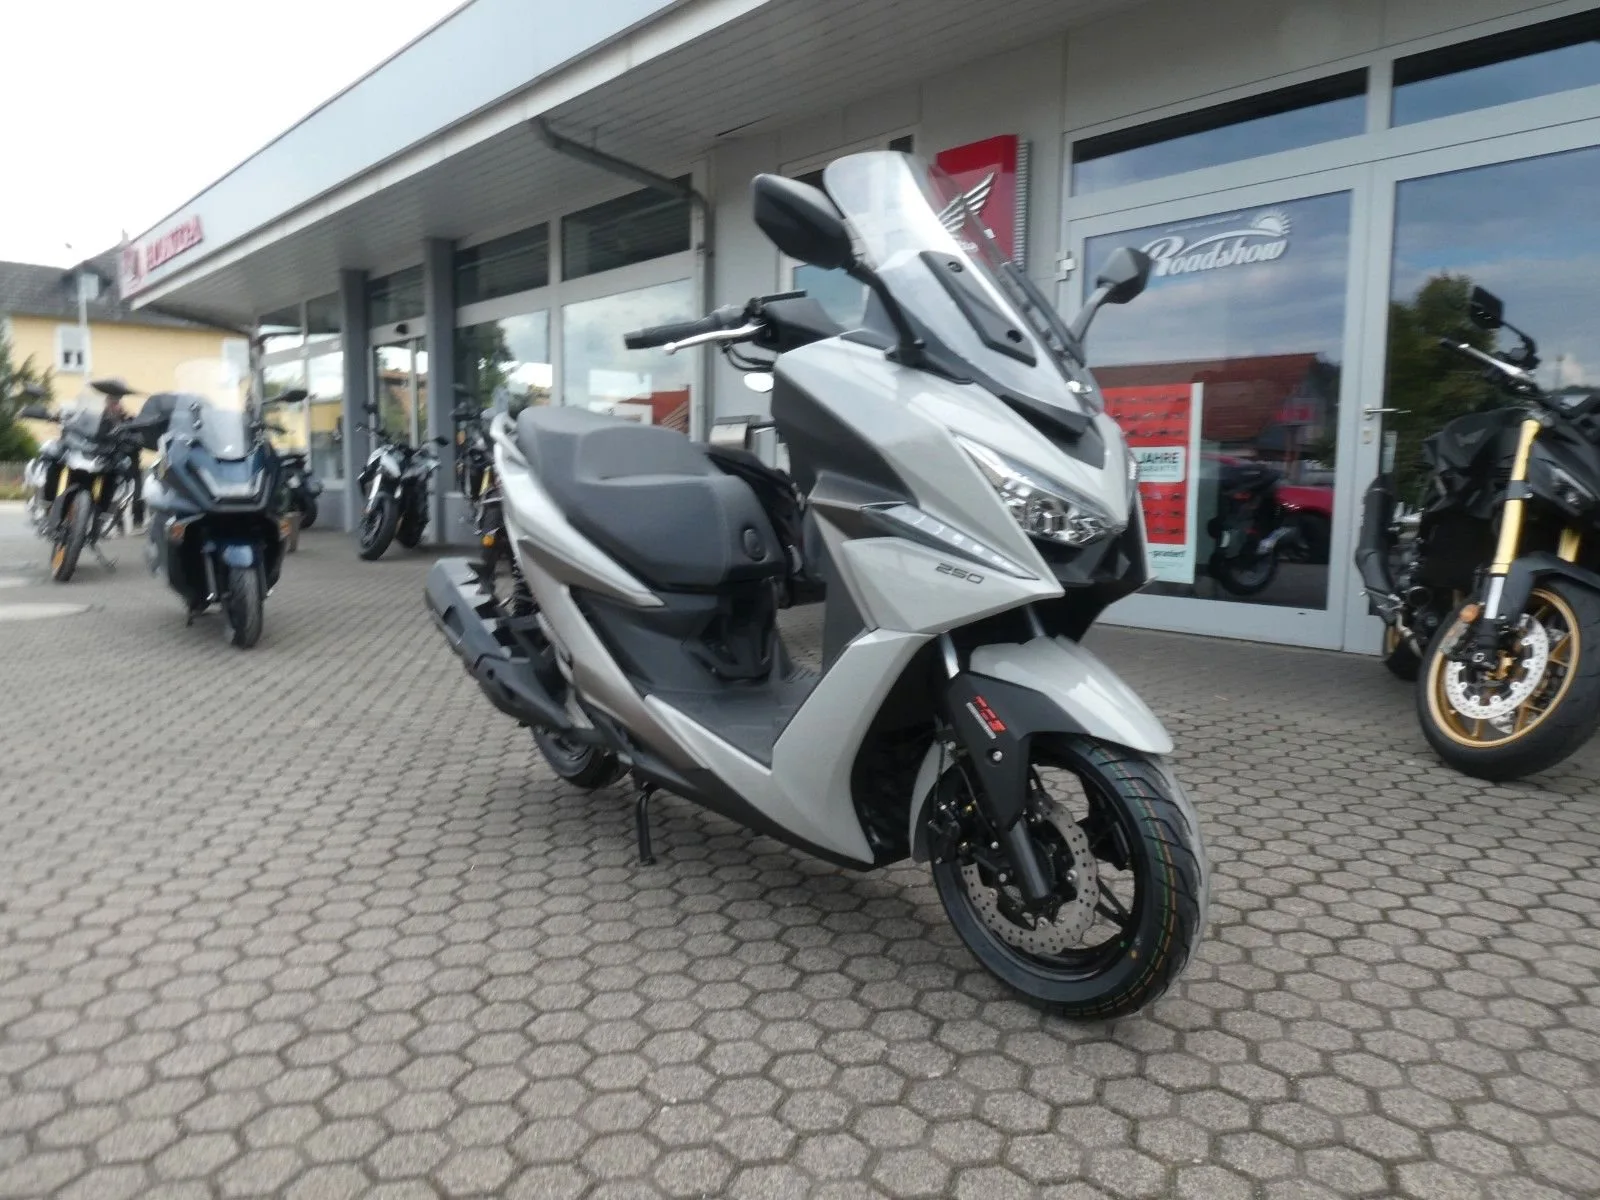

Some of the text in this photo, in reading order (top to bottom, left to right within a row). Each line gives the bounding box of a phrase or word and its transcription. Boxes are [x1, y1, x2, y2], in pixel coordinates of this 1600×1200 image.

[1140, 235, 1288, 276] Roadshow
[1138, 452, 1180, 464] JAHRE
[936, 562, 985, 584] 250
